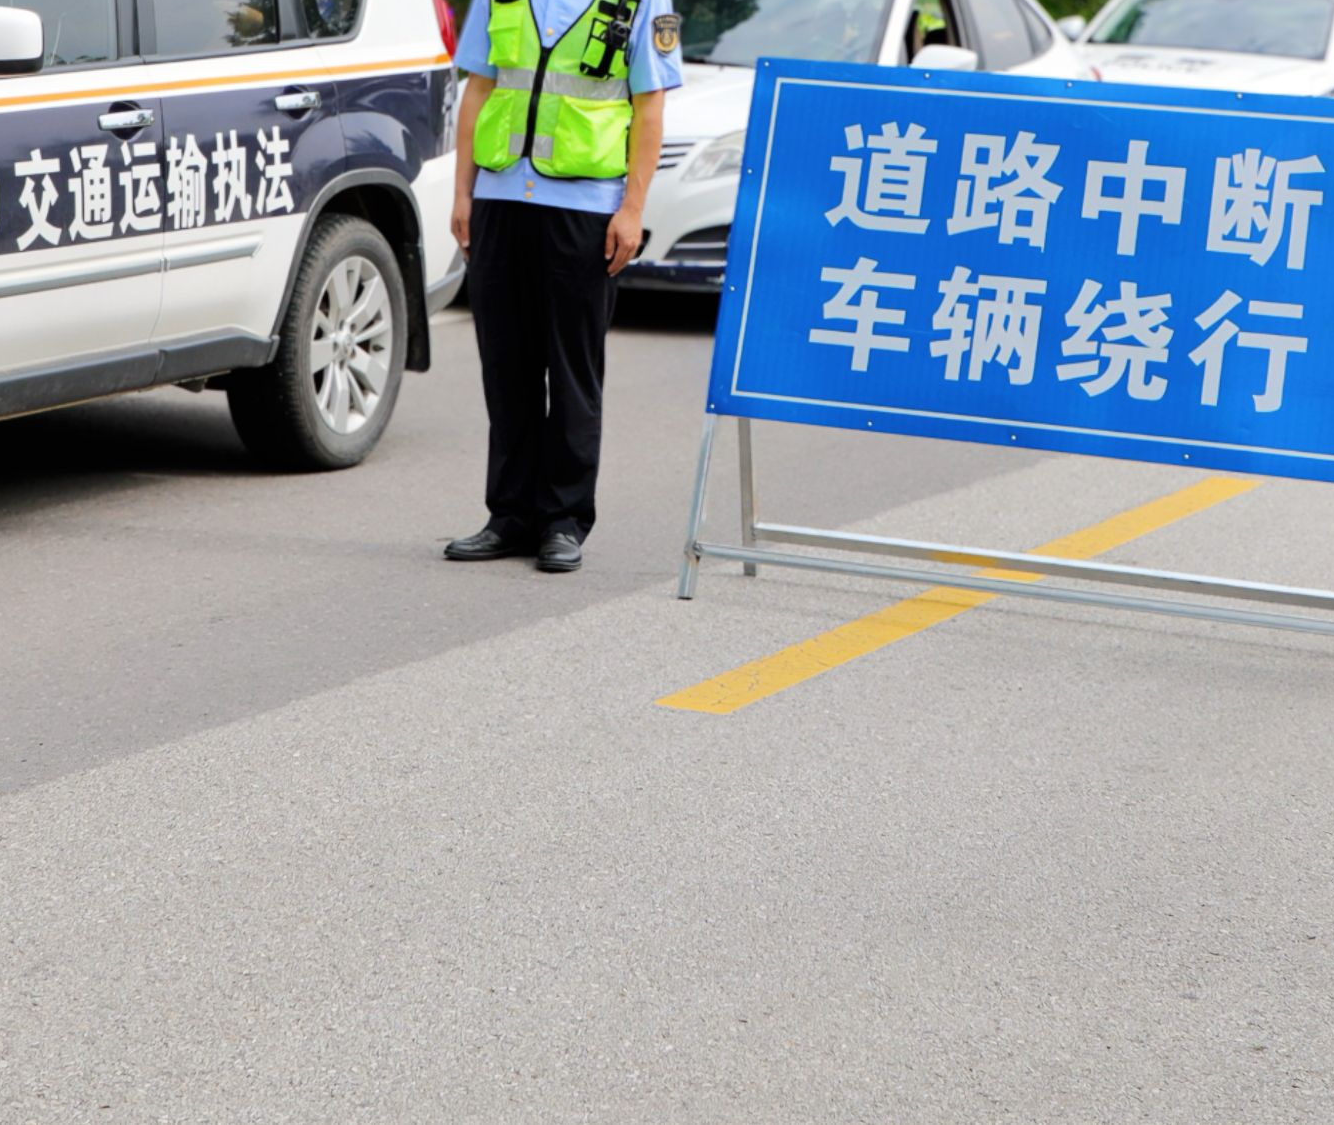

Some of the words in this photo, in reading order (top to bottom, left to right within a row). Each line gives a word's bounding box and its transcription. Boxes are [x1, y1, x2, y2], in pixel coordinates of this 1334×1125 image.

[14, 125, 295, 251] 交通运输执法
[825, 121, 1326, 269] 道路中断
[809, 257, 1308, 412] 车辆绕行
